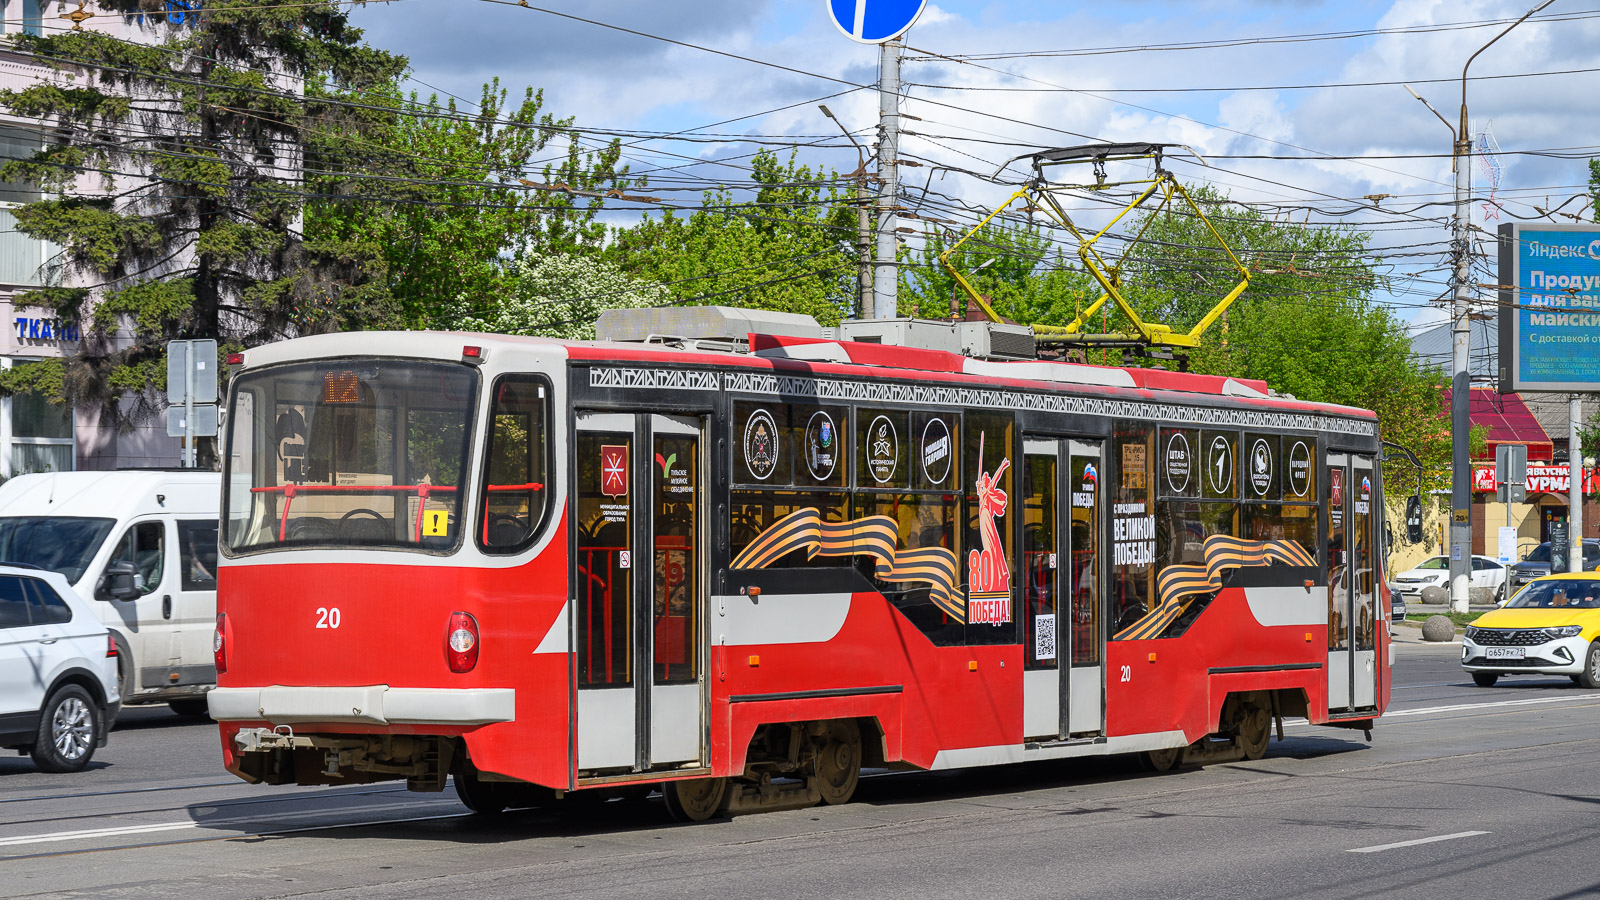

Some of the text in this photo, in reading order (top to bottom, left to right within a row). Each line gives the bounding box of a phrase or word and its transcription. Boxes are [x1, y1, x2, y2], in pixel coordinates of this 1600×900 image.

[1529, 241, 1585, 259] Яндекс
[1538, 333, 1589, 344] доставкой
[324, 370, 359, 402] 12
[1169, 450, 1184, 459] ШТАБ
[1113, 514, 1155, 541] ВЕЛИКОЙ
[1114, 541, 1155, 568] ПОБЕДЫ!
[969, 549, 992, 593] 80
[315, 607, 341, 629] 20
[969, 600, 1010, 626] ПОБЕДА!
[1121, 665, 1131, 683] 20
